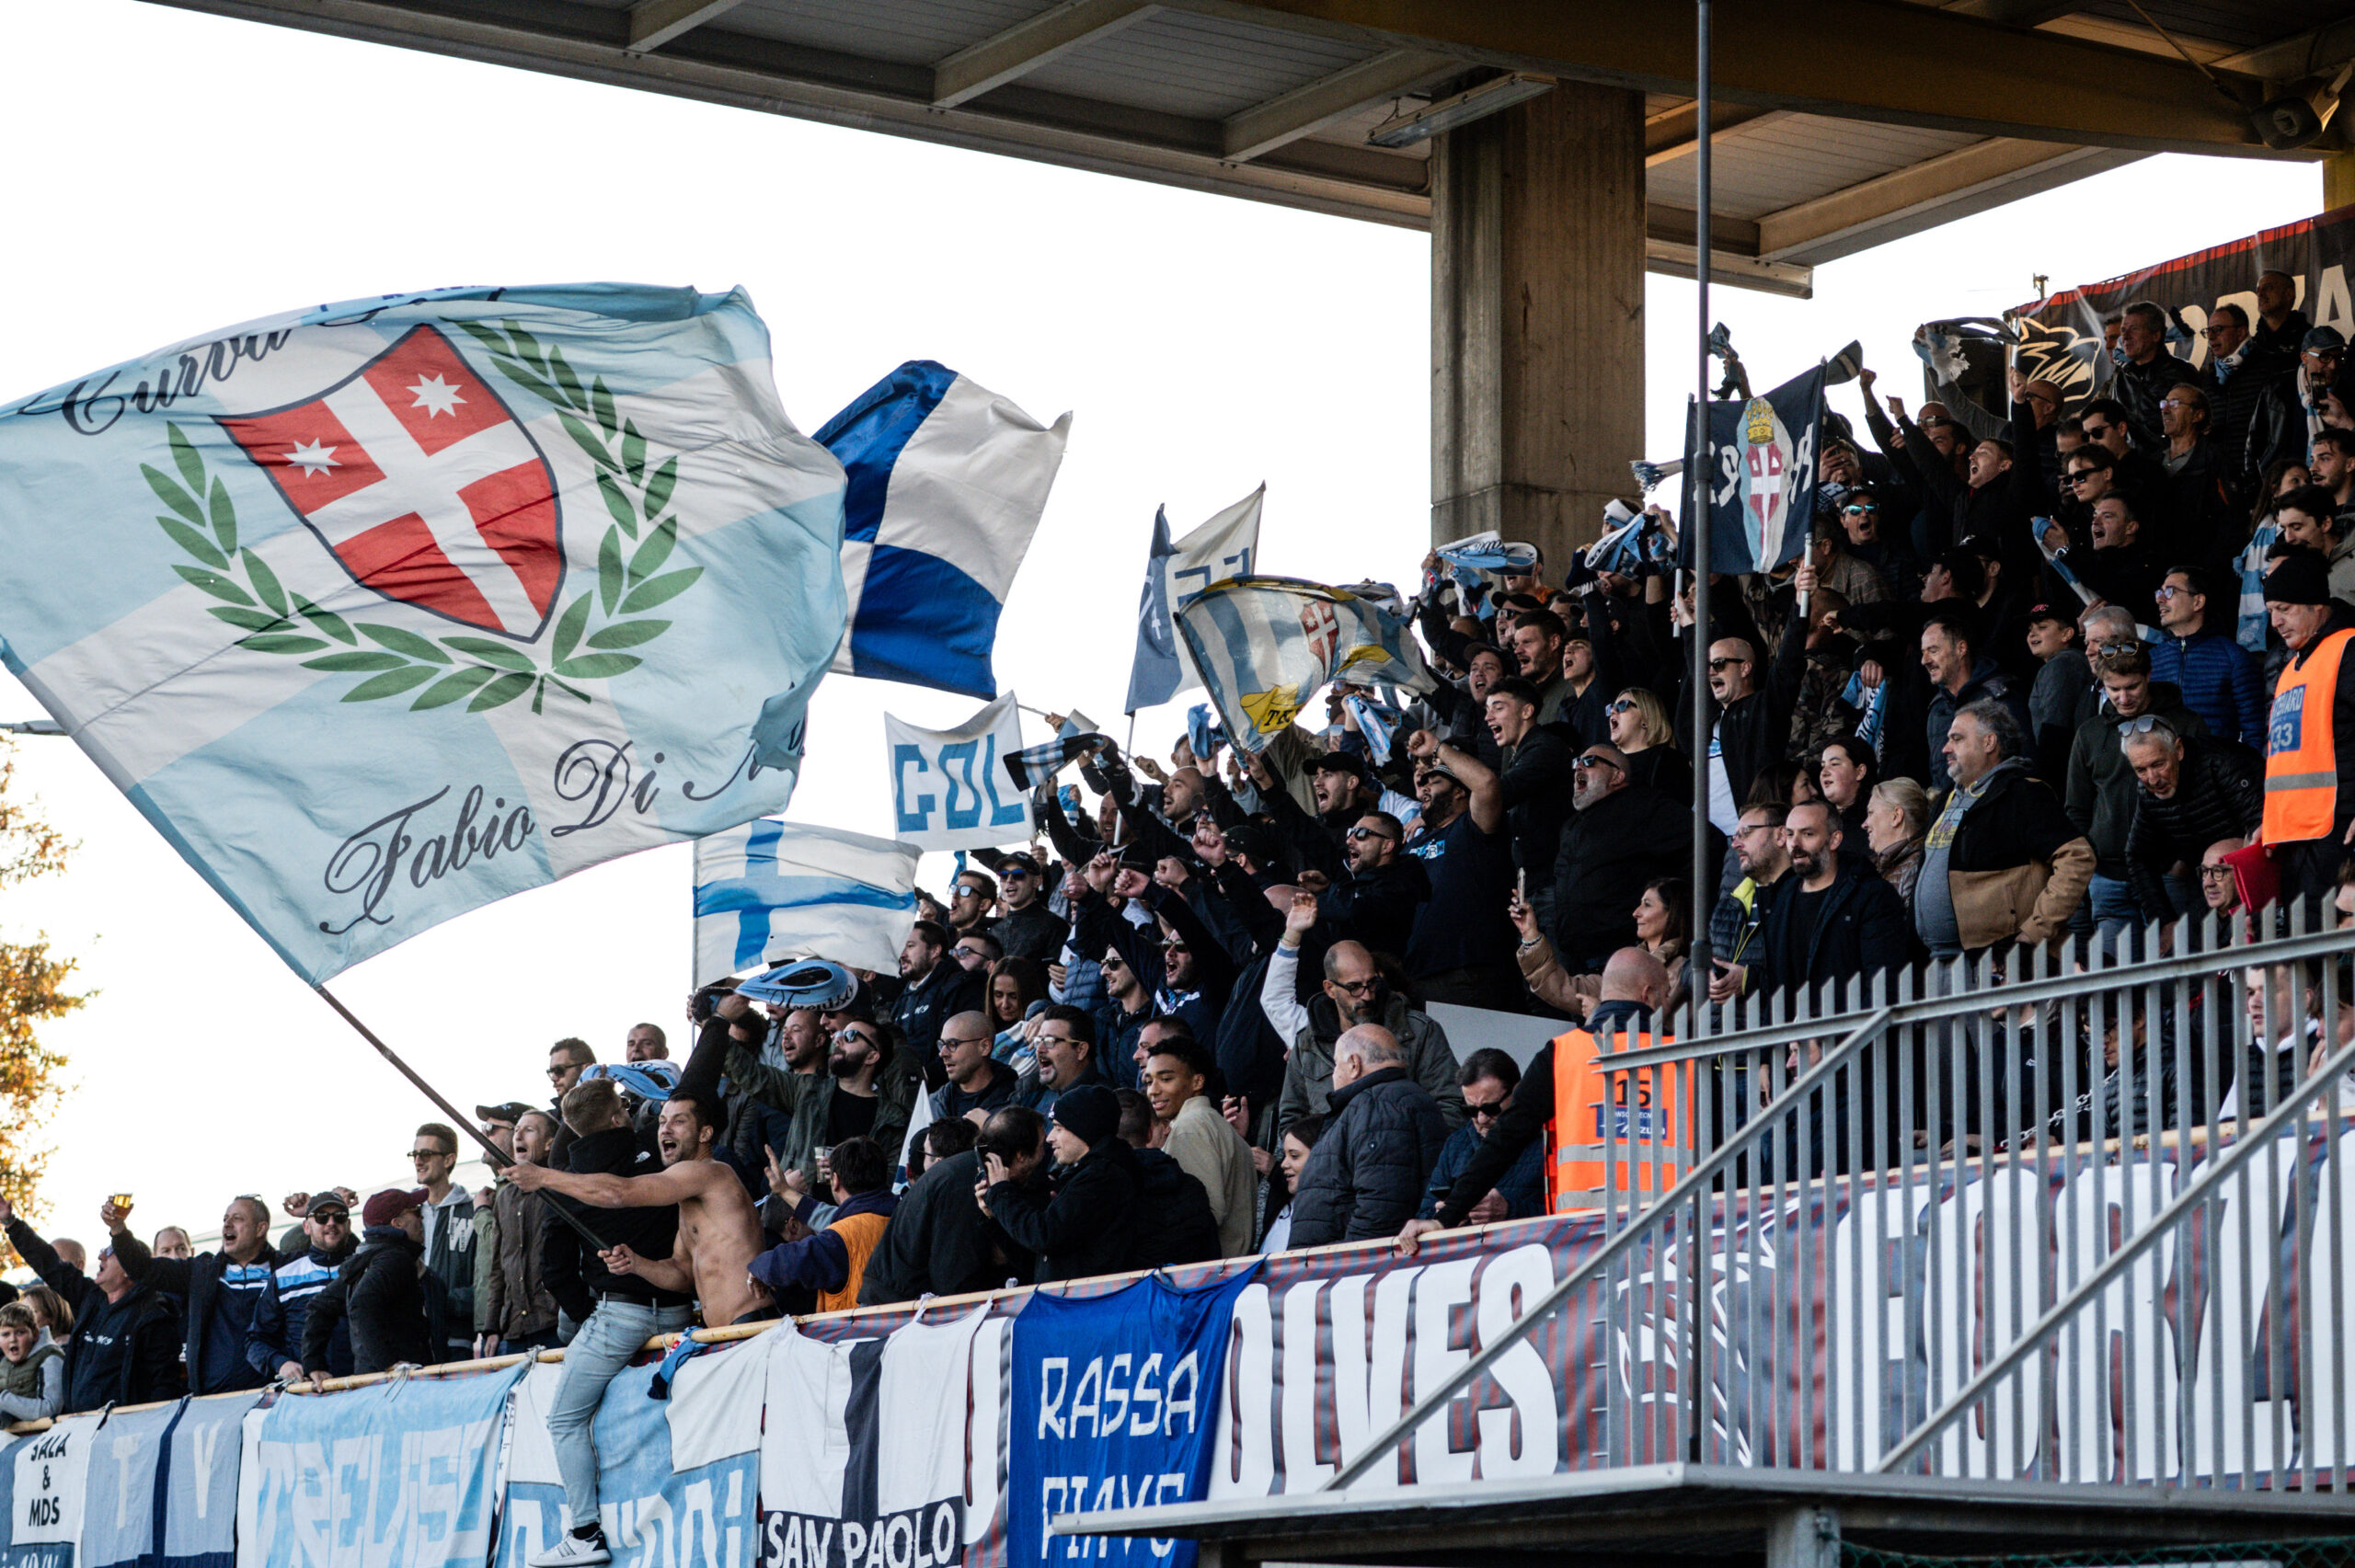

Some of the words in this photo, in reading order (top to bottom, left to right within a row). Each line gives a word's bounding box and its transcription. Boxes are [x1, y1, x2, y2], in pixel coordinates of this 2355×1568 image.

[894, 733, 1026, 832] GOL
[319, 784, 535, 934] Fabio
[551, 738, 664, 837] Di
[1616, 1079, 1651, 1107] 15
[1039, 1349, 1199, 1440] RASSA
[1207, 1243, 1558, 1501] OLVES
[30, 1432, 71, 1461] SALA
[42, 1464, 51, 1490] &
[29, 1496, 60, 1528] MDS
[766, 1511, 833, 1568] SAN
[842, 1501, 956, 1568] PAOLO
